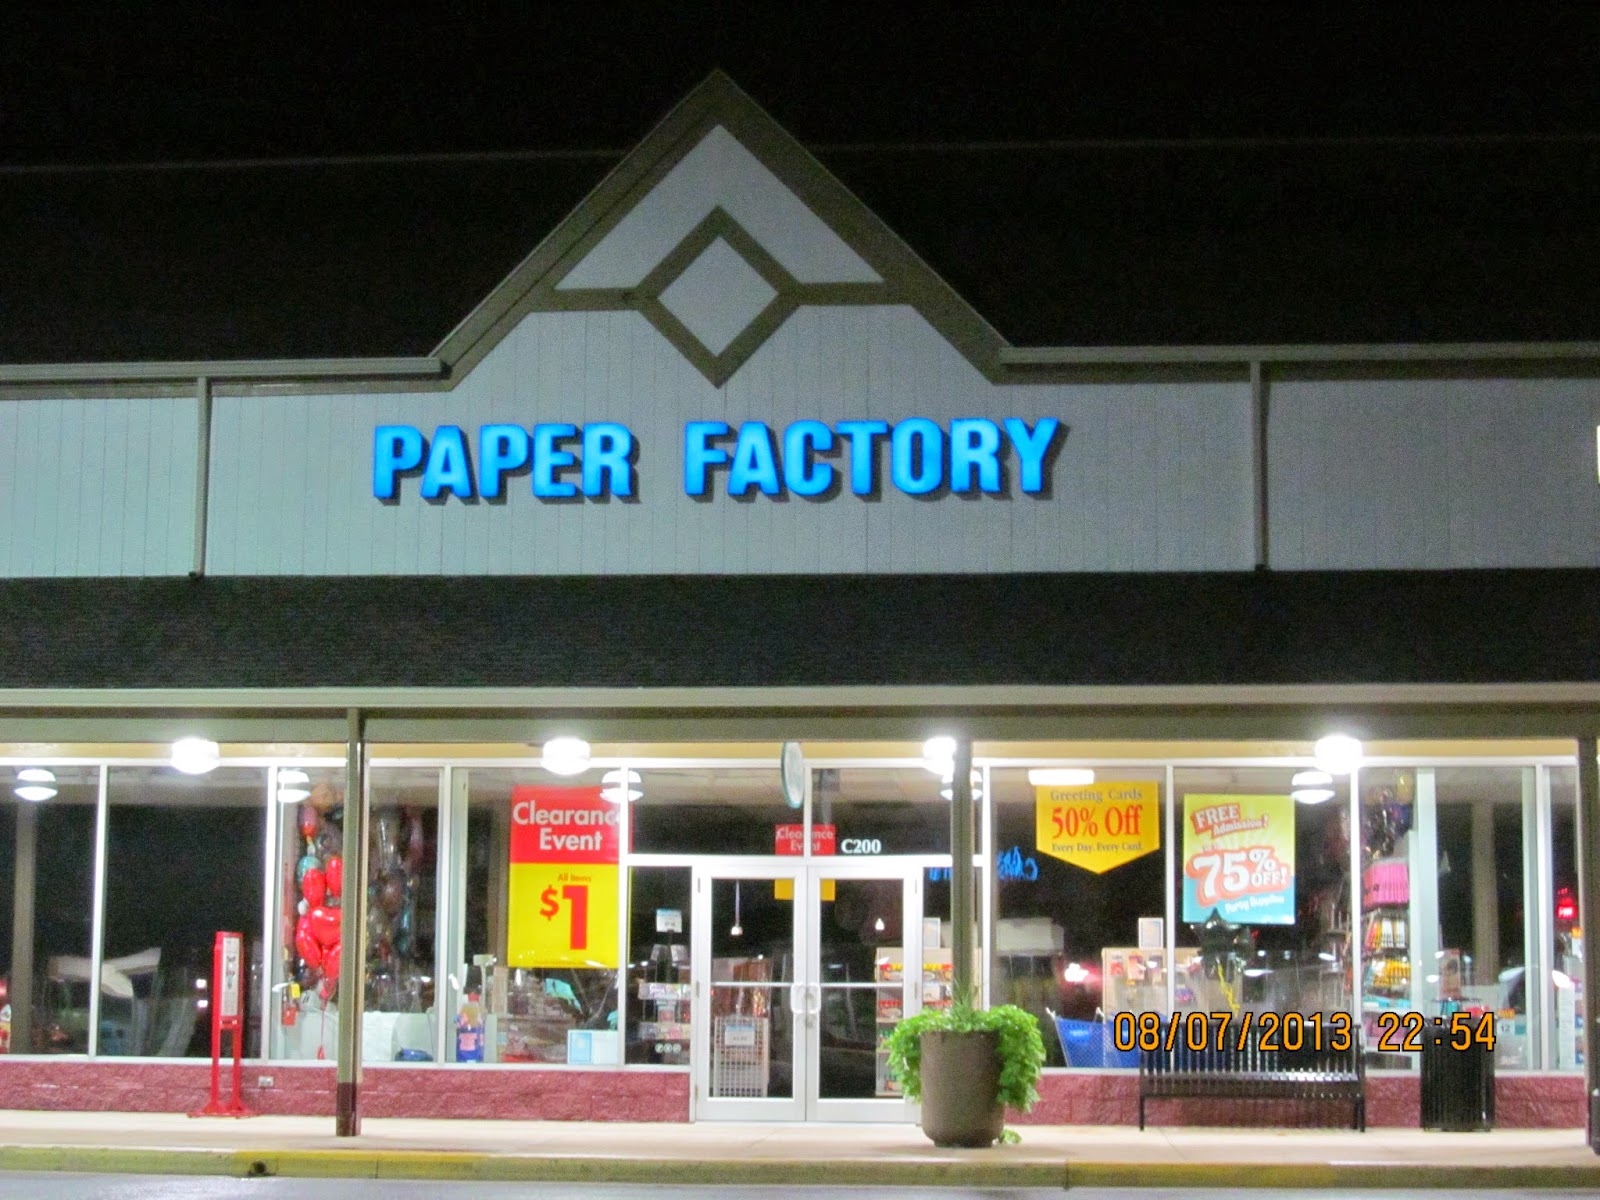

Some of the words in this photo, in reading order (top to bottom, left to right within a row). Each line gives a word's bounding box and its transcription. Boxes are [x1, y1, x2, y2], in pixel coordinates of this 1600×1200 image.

[372, 421, 634, 500] PAPER
[684, 417, 1060, 498] FACTORY
[1050, 788, 1103, 804] Greeting
[1108, 787, 1143, 801] Cards
[513, 800, 620, 826] Clearanc
[1051, 806, 1099, 839] 50%
[1104, 804, 1144, 837] Off
[1195, 804, 1239, 829] FREE
[540, 827, 603, 851] Event
[790, 840, 821, 852] Evnt
[841, 838, 882, 855] C200
[1052, 842, 1075, 853] Every
[1097, 841, 1121, 853] Every
[557, 873, 569, 882] All
[570, 874, 592, 883] Items
[1193, 848, 1277, 899] 75%
[1251, 866, 1288, 888] OFF!
[540, 884, 589, 950] $1
